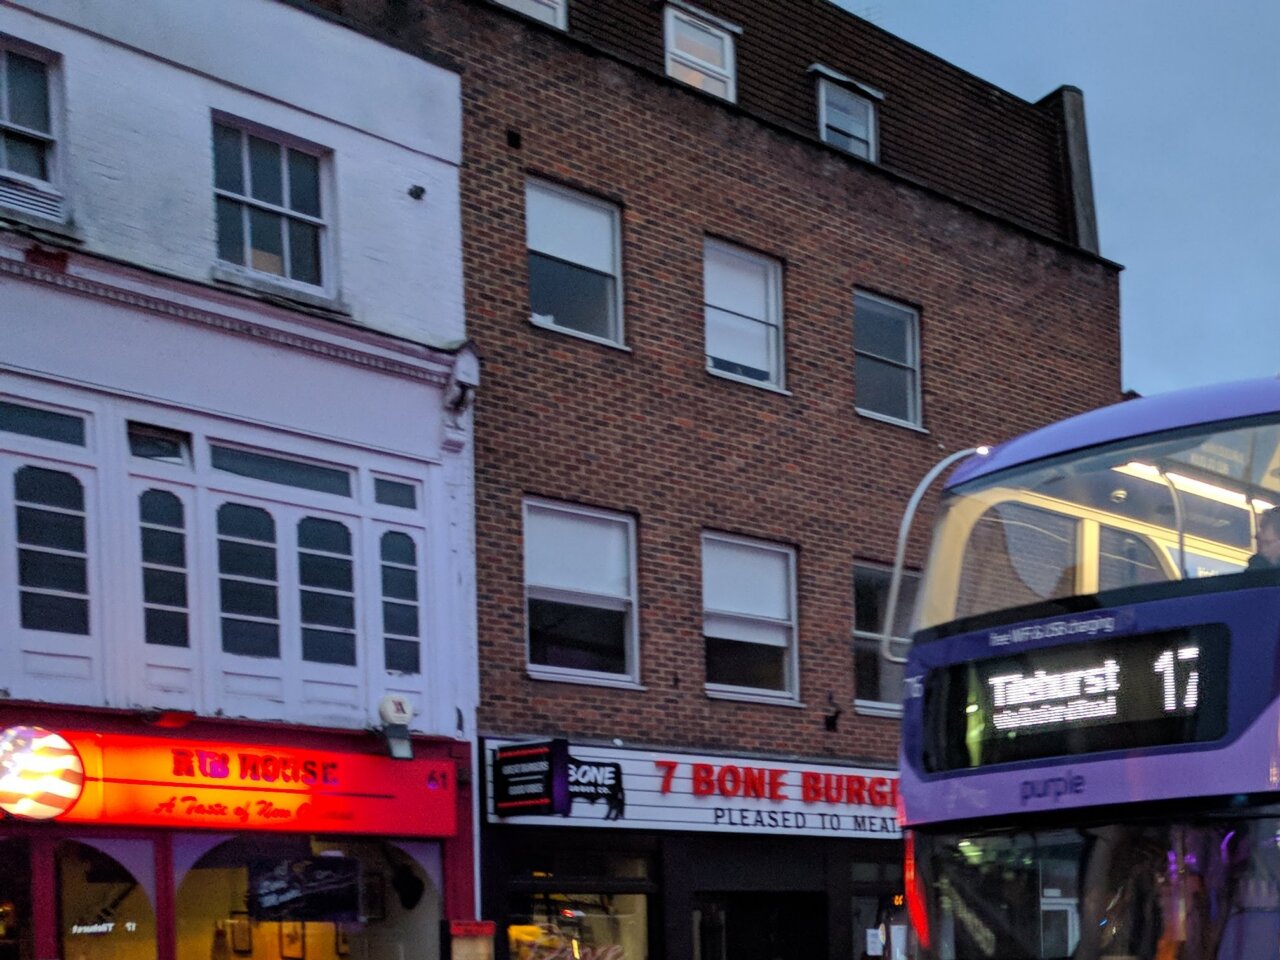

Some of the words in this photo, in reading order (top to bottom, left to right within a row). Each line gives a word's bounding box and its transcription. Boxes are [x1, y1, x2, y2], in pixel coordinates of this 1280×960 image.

[1153, 646, 1199, 711] 17
[655, 759, 679, 795] 7
[691, 763, 790, 803] BONE
[1020, 772, 1086, 805] purple
[714, 807, 806, 829] PLEASED
[819, 812, 841, 831] TO
